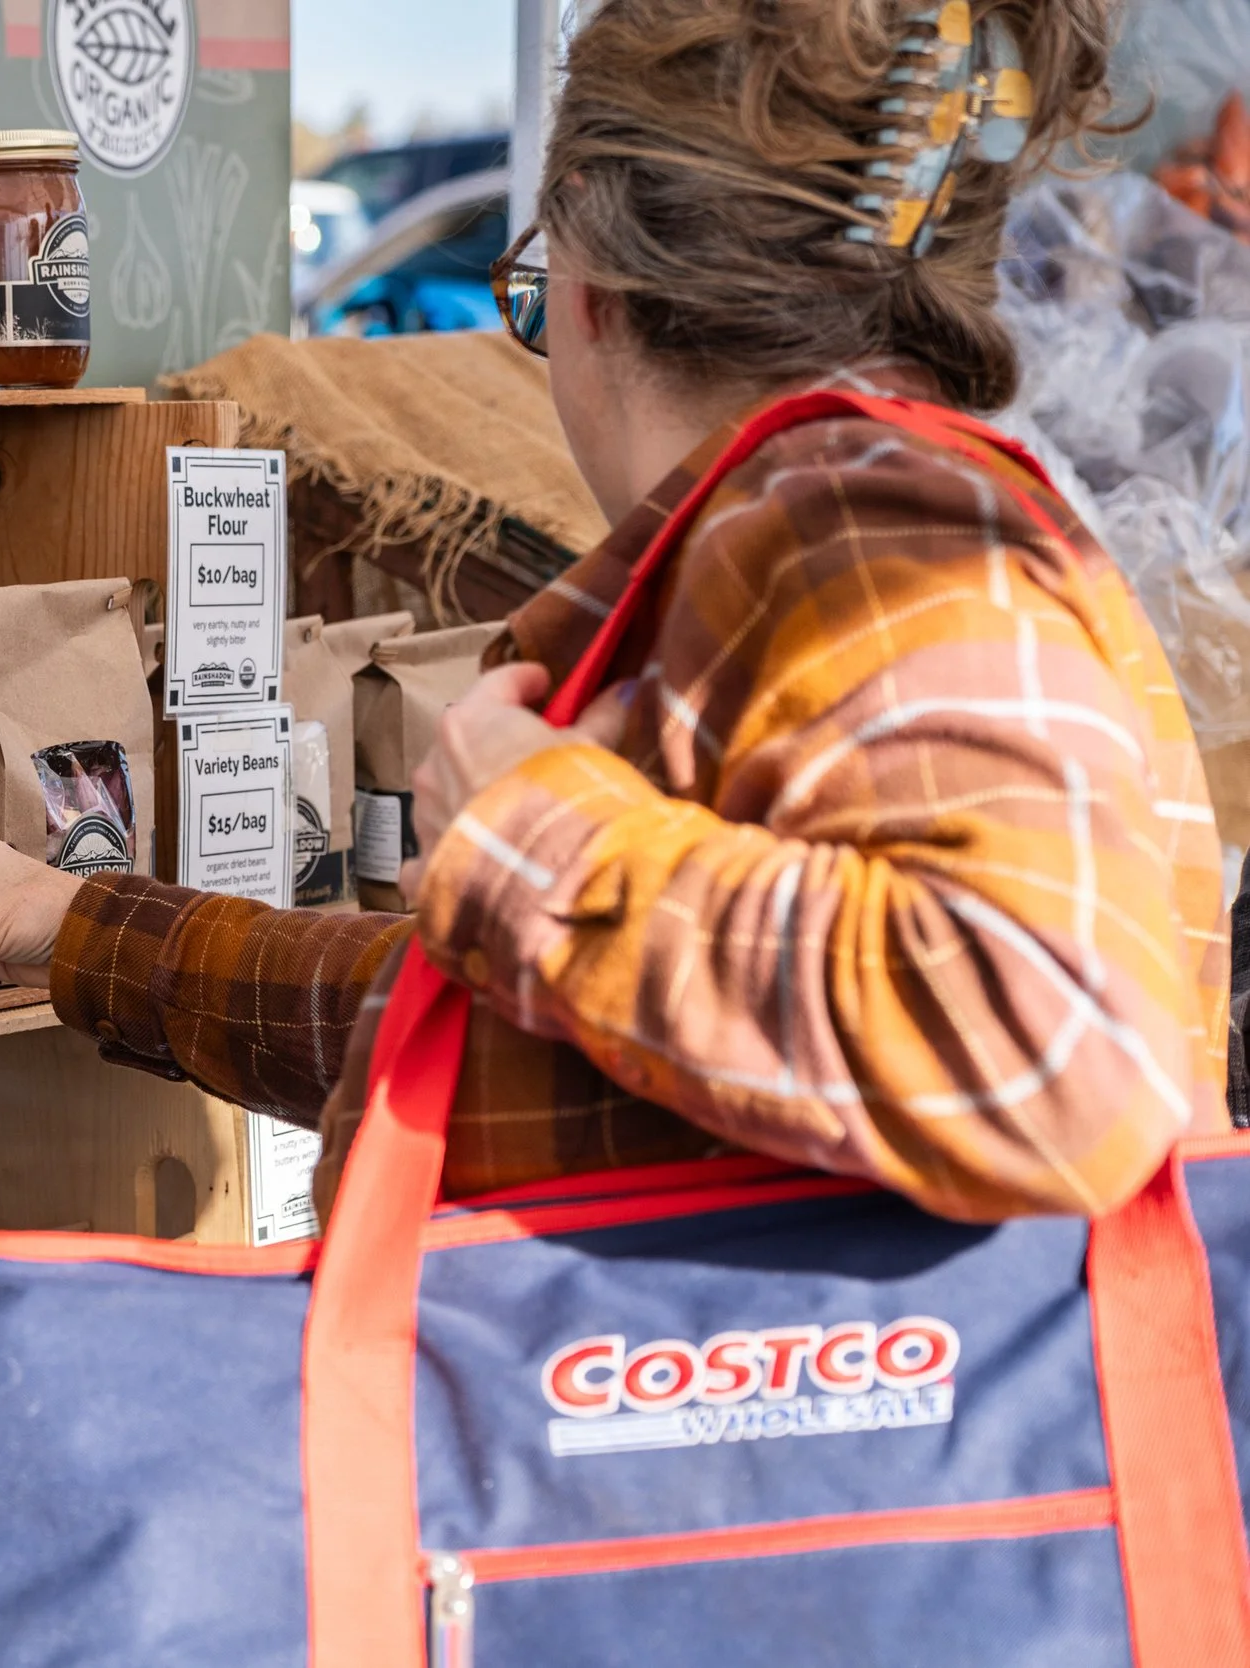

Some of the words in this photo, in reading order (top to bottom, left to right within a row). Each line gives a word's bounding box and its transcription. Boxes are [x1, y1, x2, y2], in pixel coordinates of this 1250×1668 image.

[40, 264, 89, 278] RAINSHA
[183, 486, 271, 508] Buckwheat
[208, 514, 248, 536] Flour
[198, 563, 257, 588] $10/bag
[192, 621, 207, 632] very
[248, 618, 260, 629] and
[206, 634, 228, 648] slightly
[229, 634, 246, 645] bitter
[194, 671, 232, 681] RAINSHADOW
[195, 756, 240, 777] Variety
[243, 754, 279, 771] Beans
[208, 811, 267, 836] $15/bag
[206, 861, 230, 874] organic
[230, 858, 247, 869] dried
[248, 857, 267, 868] beans
[201, 875, 232, 888] harvested
[233, 875, 241, 886] by
[241, 871, 258, 882] hand
[259, 870, 271, 881] and
[546, 1320, 955, 1413] COSTCO
